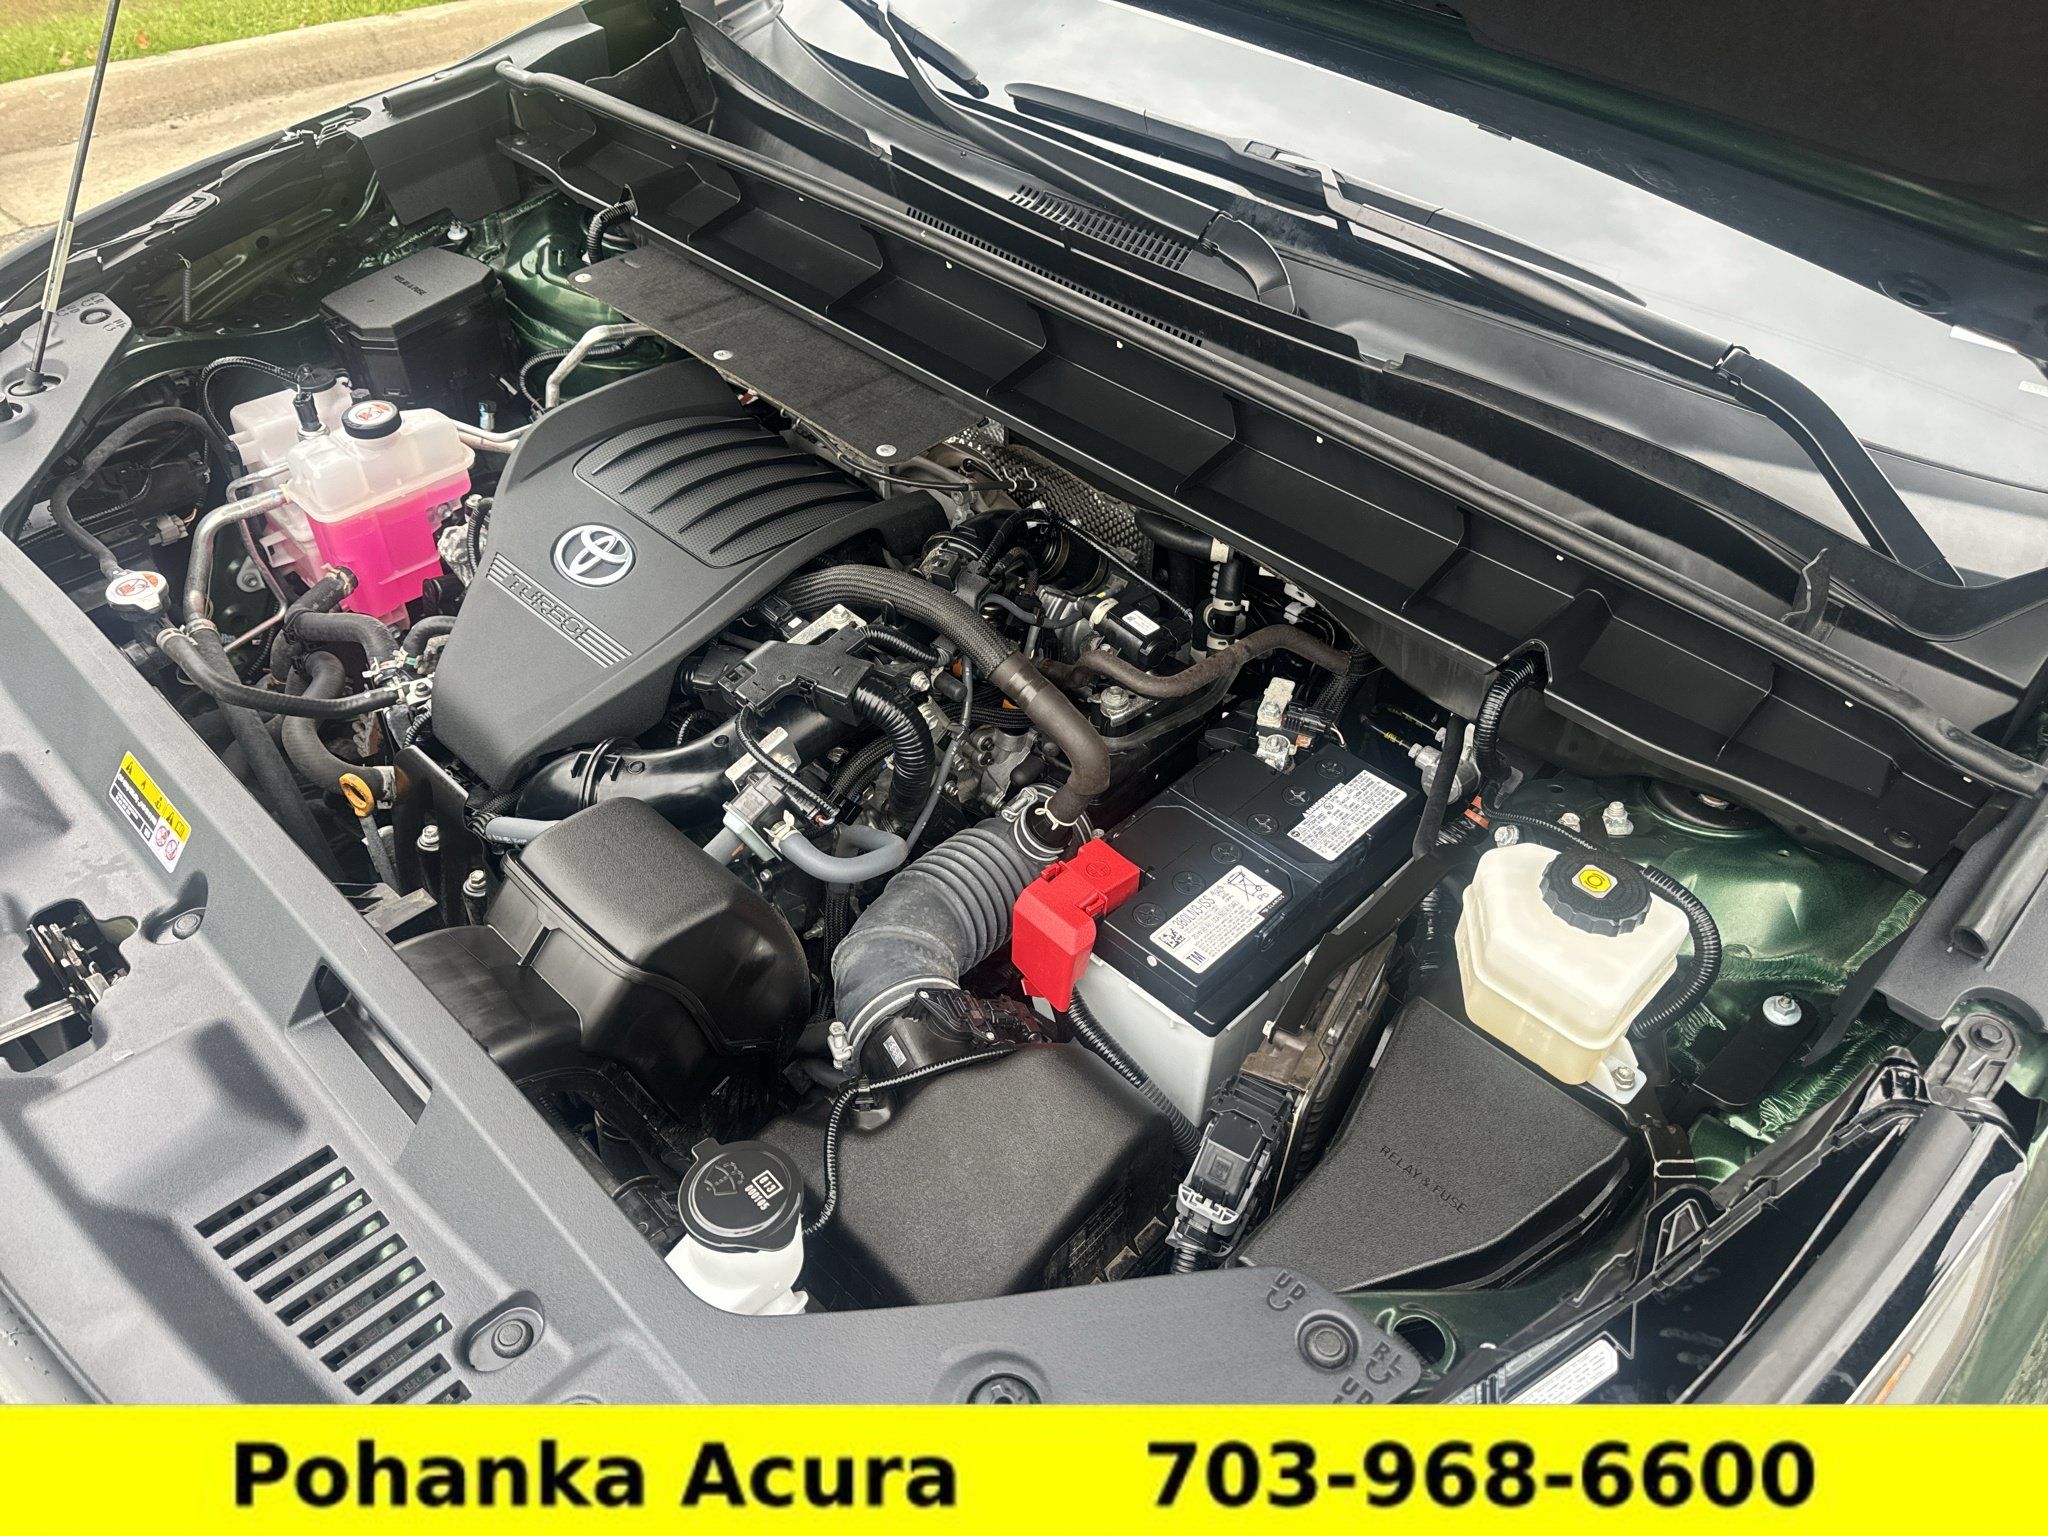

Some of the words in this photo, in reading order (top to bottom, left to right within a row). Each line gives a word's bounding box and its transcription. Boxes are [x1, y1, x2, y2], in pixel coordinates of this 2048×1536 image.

[508, 572, 585, 637] TURBO
[1185, 948, 1208, 967] TM
[744, 1184, 771, 1210] 000105
[1379, 1145, 1423, 1179] RELAY
[1420, 1176, 1432, 1188] &
[1432, 1184, 1468, 1215] FUSE
